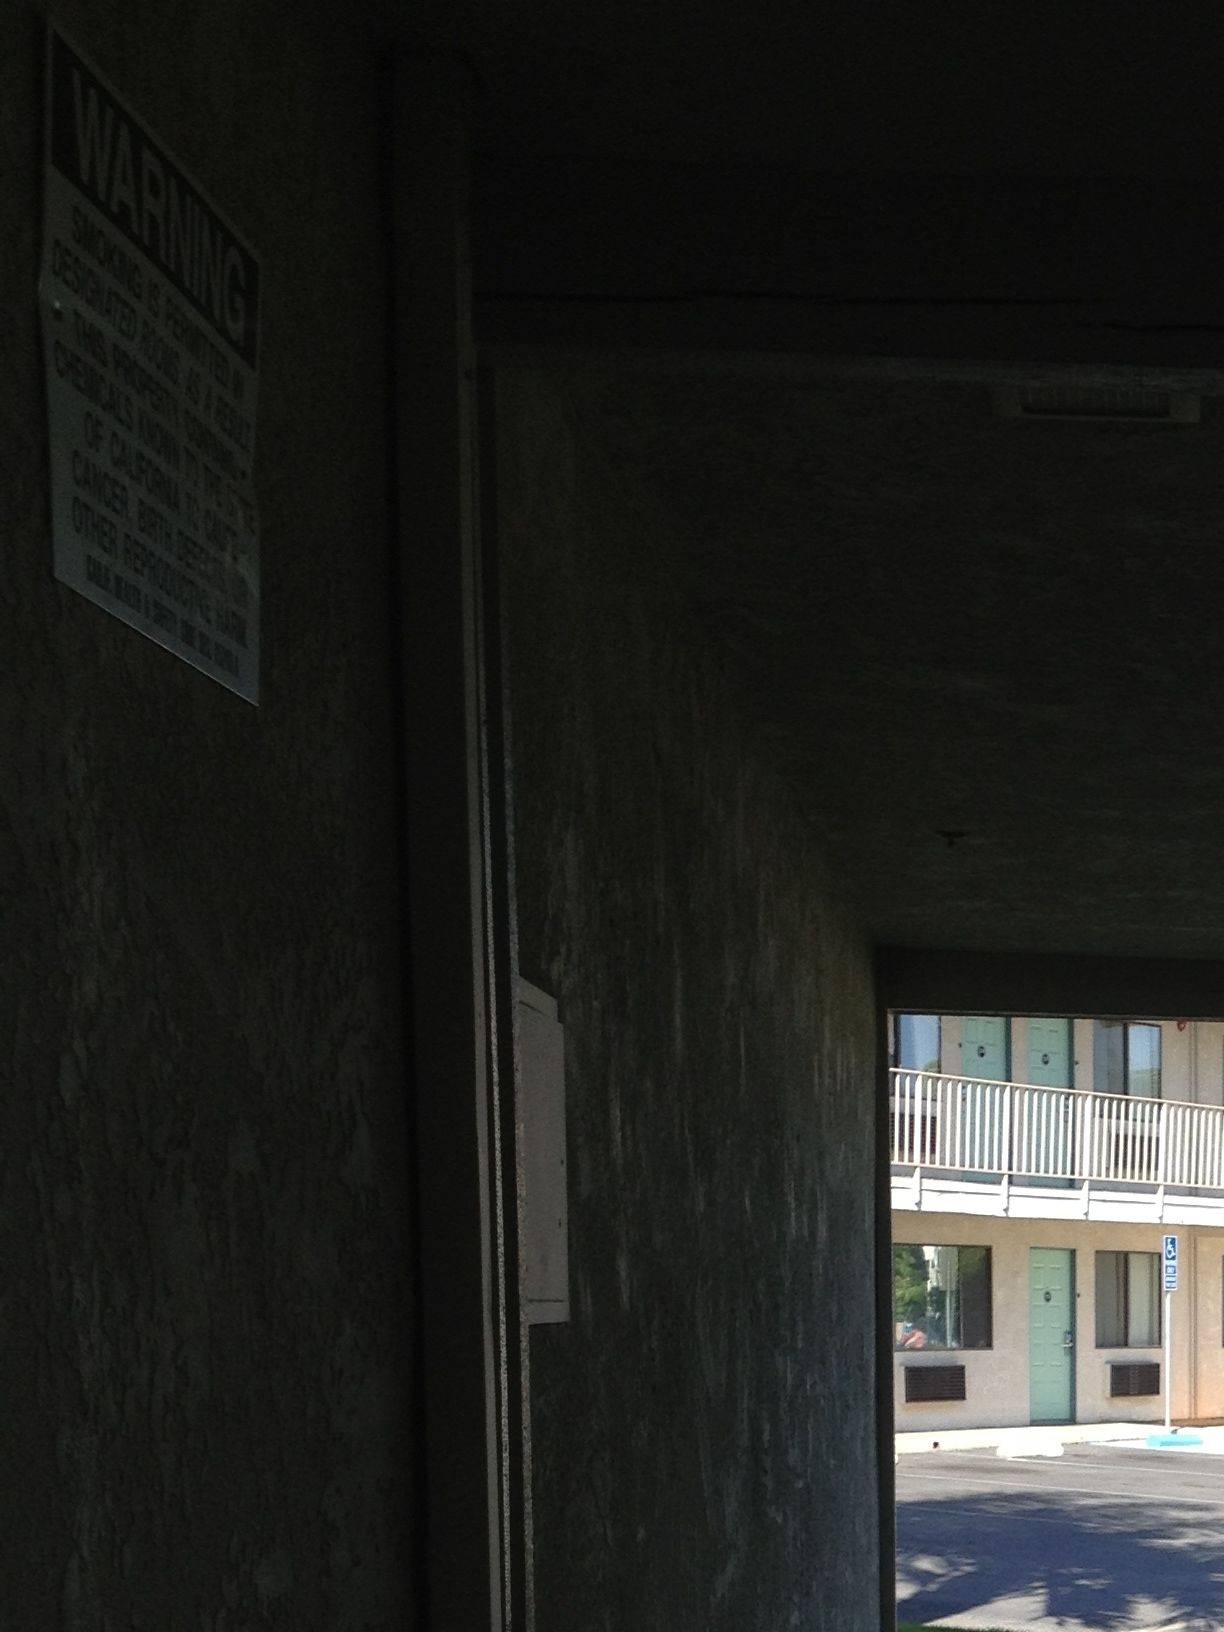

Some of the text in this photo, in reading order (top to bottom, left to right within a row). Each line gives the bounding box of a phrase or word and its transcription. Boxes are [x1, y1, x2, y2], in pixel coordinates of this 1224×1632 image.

[73, 68, 245, 344] WARNING
[51, 232, 137, 349] DESIGNATED
[185, 361, 200, 408] AS
[71, 201, 141, 304] SMOKING
[147, 275, 159, 321] IS
[166, 294, 229, 391] PERMITTED
[73, 306, 107, 368] THIS
[54, 334, 133, 435] CHEMICALS
[84, 407, 103, 457] OF
[110, 428, 179, 516] CALIFORNIA
[72, 493, 116, 559] OTHER
[138, 496, 173, 556] BIRTH
